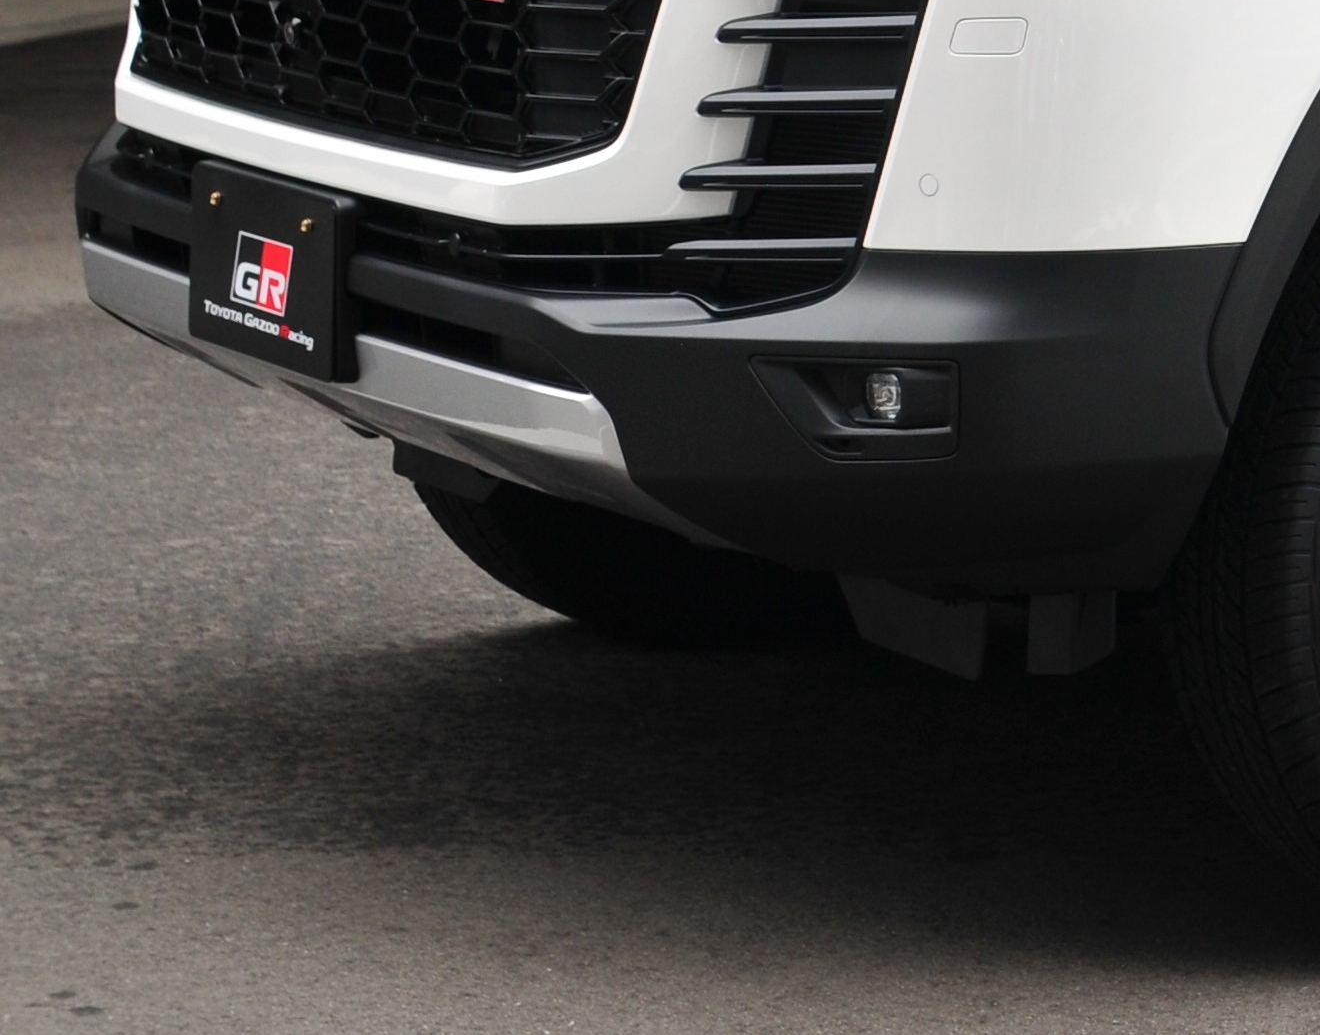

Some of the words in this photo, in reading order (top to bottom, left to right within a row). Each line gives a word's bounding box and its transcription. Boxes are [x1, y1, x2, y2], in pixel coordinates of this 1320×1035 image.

[234, 261, 286, 310] GR
[203, 299, 243, 324] TOYOTA
[243, 312, 280, 336] GAZOO
[279, 324, 315, 351] Racing
